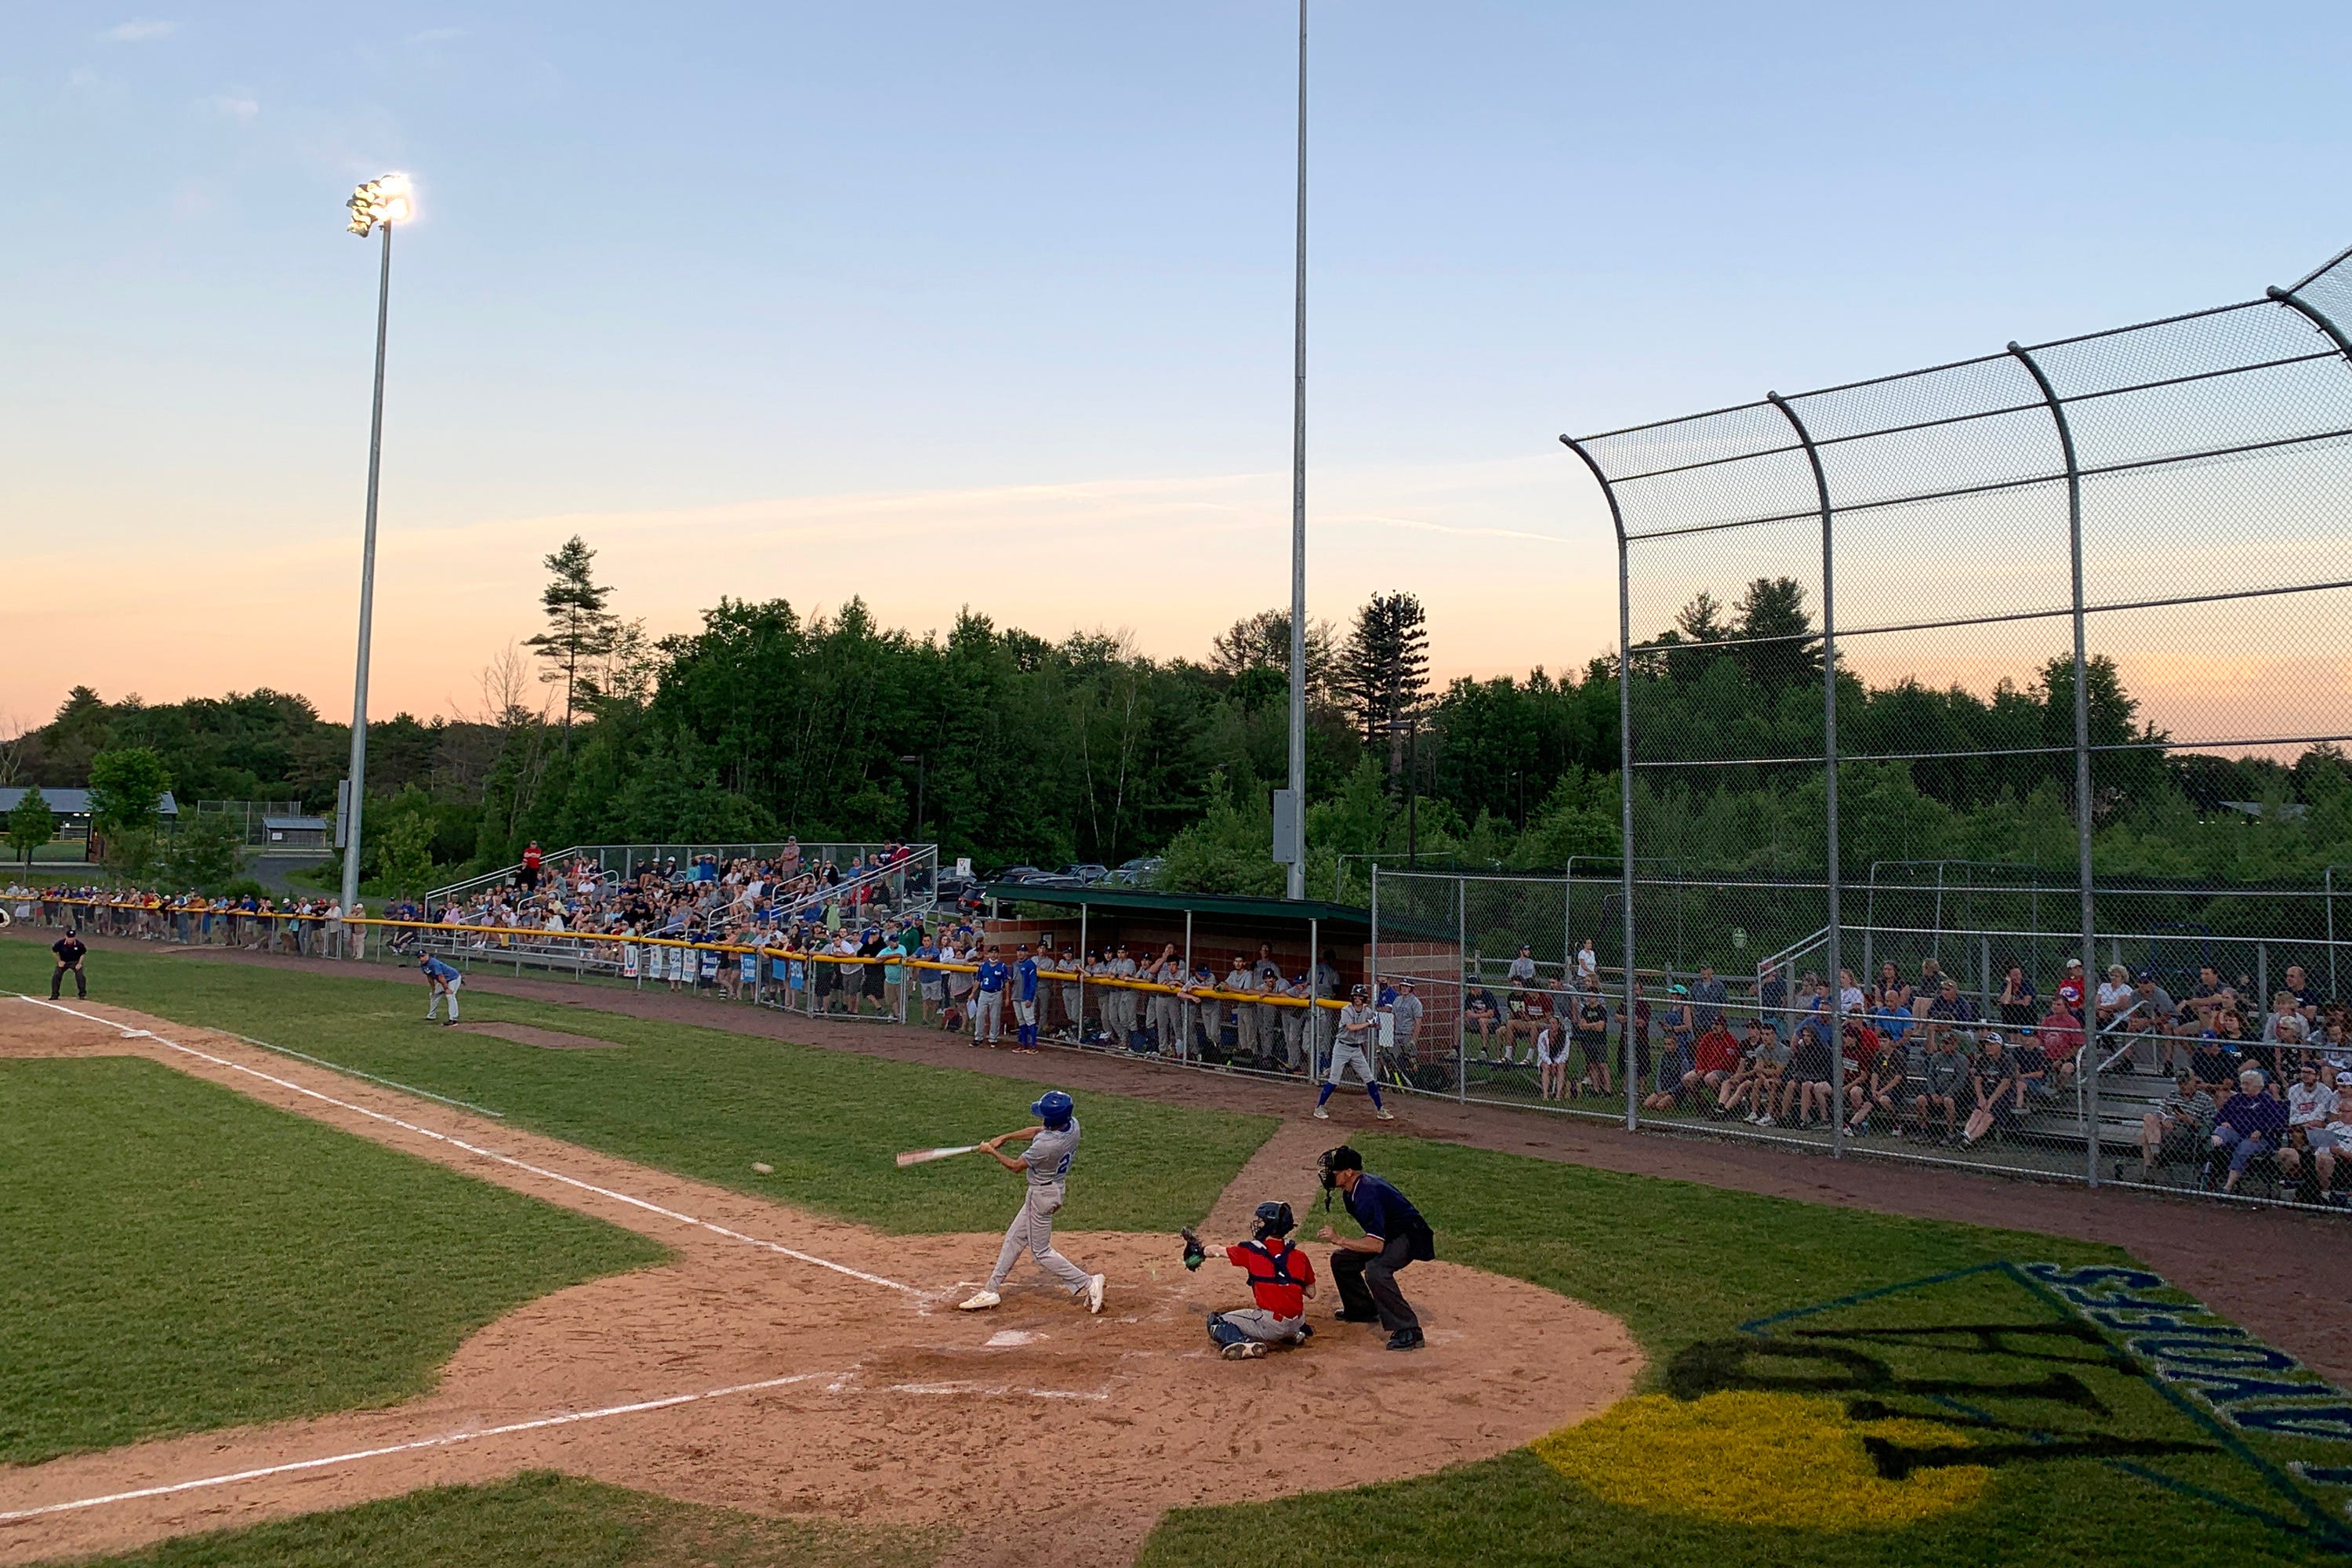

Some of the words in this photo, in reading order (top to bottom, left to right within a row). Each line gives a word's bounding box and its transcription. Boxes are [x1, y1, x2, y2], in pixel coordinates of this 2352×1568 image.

[1318, 971, 1325, 984] 7
[1667, 1320, 2225, 1480] VPA
[2016, 1262, 2352, 1515] AYOFFS
